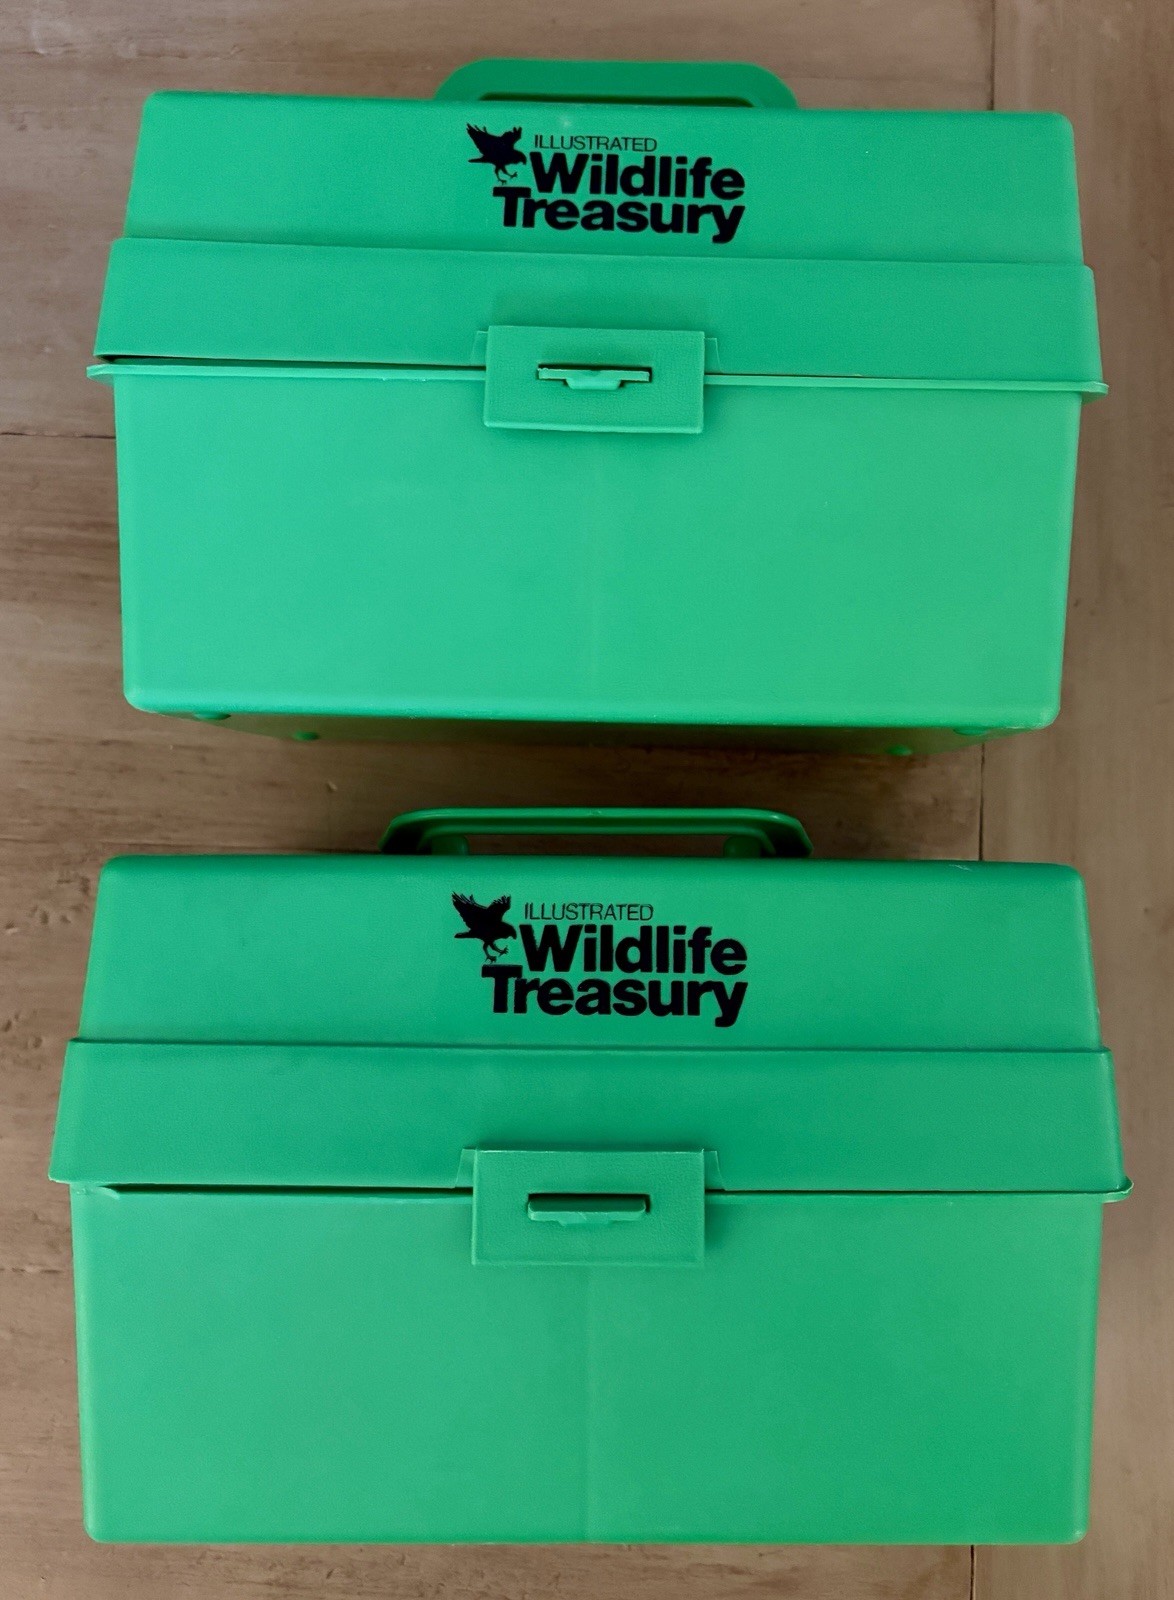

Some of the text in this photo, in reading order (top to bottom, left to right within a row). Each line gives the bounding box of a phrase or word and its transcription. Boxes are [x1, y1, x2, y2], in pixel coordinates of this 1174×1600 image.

[534, 134, 658, 152] ILLUSTRATED
[529, 151, 746, 201] Wildlife
[492, 186, 746, 245] Treasury
[524, 902, 654, 921] ILLUSTRATED
[518, 923, 748, 976] Wildlife
[481, 964, 749, 1028] Treasury
